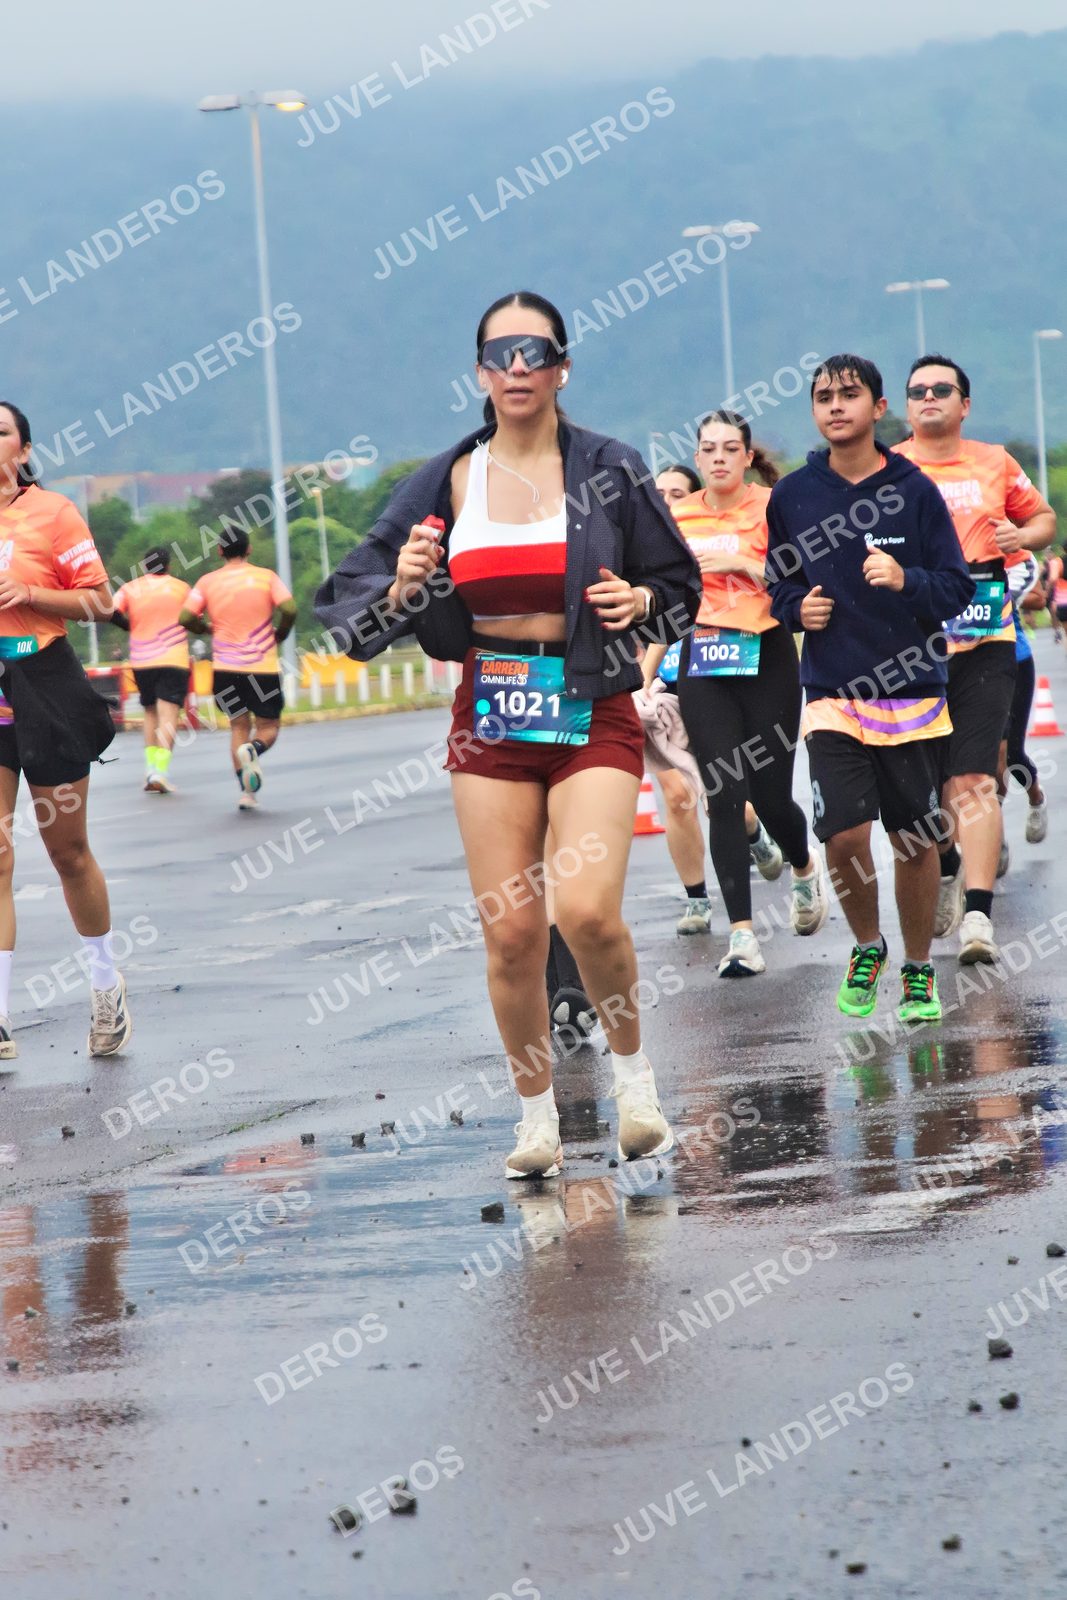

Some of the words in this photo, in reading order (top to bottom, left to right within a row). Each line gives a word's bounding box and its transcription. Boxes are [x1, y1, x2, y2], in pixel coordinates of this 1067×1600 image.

[956, 604, 991, 621] 003
[16, 641, 33, 653] 10K
[700, 644, 740, 661] 1002
[481, 660, 529, 675] CARRERA
[494, 690, 561, 718] 1021
